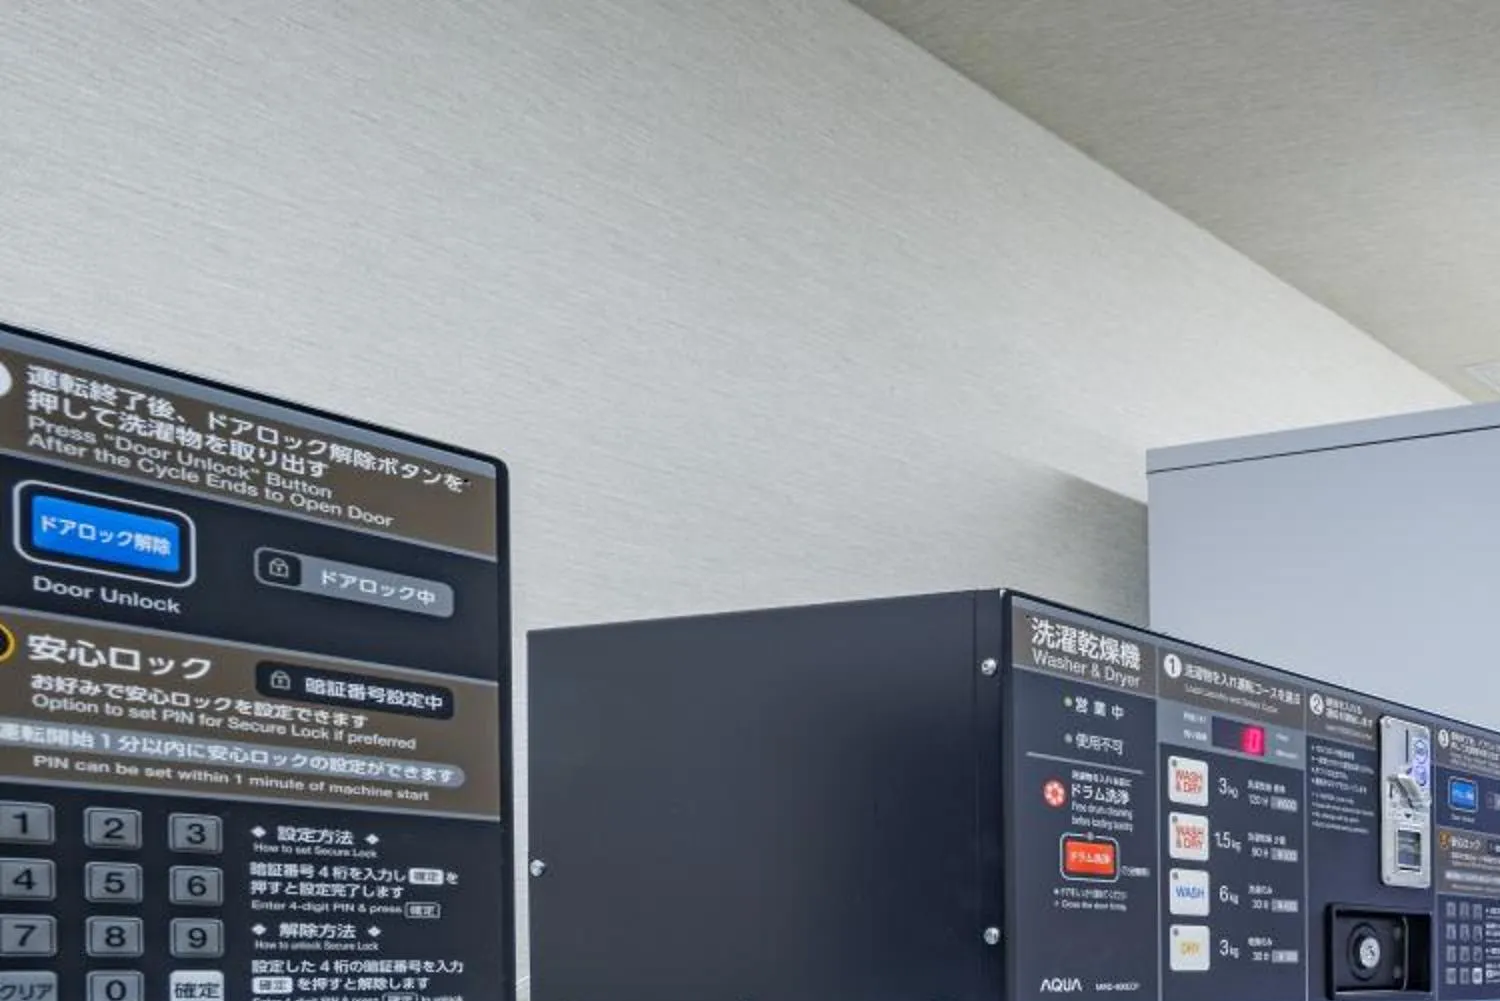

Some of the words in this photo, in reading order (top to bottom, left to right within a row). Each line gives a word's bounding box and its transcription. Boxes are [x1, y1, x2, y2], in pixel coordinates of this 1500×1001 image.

[27, 389, 329, 478] 押して洗濯物を取り出す
[28, 415, 97, 444] Press
[266, 470, 333, 499] Button
[27, 433, 86, 458] After
[95, 447, 131, 468] the
[136, 457, 199, 484] Cycle
[205, 473, 259, 498] Ends
[264, 484, 284, 502] to
[289, 492, 342, 517] Open
[347, 504, 395, 528] Door
[40, 515, 172, 558] ドアロック解除
[33, 575, 92, 600] Door
[99, 586, 181, 615] Unlock
[320, 569, 436, 606] ドアロック中
[28, 634, 212, 679] 安心ロック
[1031, 617, 1140, 671] 洗濯乾燥機
[1032, 648, 1086, 676] Washer
[1091, 661, 1100, 678] &
[1104, 664, 1140, 689] Dryer
[304, 677, 444, 711] 暗証番号設定中
[32, 693, 98, 713] Option
[104, 702, 124, 717] to
[129, 706, 157, 721] set
[163, 709, 193, 725] PIN
[199, 714, 222, 729] for
[227, 716, 287, 736] Secure
[291, 724, 329, 741] Lock
[334, 728, 344, 741] if
[348, 732, 417, 750] preferred
[33, 755, 68, 771] PIN
[75, 760, 109, 774] can
[116, 762, 139, 776] be
[144, 766, 172, 780] set
[177, 769, 229, 785] within
[235, 773, 242, 785] 1
[249, 775, 304, 791] minute
[309, 781, 325, 792] of
[329, 783, 393, 799] machine
[397, 787, 429, 801] start
[13, 811, 30, 834] 1
[104, 817, 125, 839] 2
[187, 823, 207, 845] 3
[277, 825, 354, 845] 設定方法
[13, 869, 35, 892] 4
[104, 872, 125, 894] 5
[187, 875, 207, 897] 6
[250, 879, 404, 899] 押すと設定完了します
[1176, 885, 1204, 898] WASH
[14, 925, 36, 948] 7
[105, 926, 126, 949] 8
[187, 927, 207, 950] 9
[279, 923, 357, 939] 解除方法
[0, 982, 53, 1000] クリア
[105, 979, 127, 1001] 0
[174, 981, 221, 1000] 確定
[1040, 978, 1083, 992] AQUA
